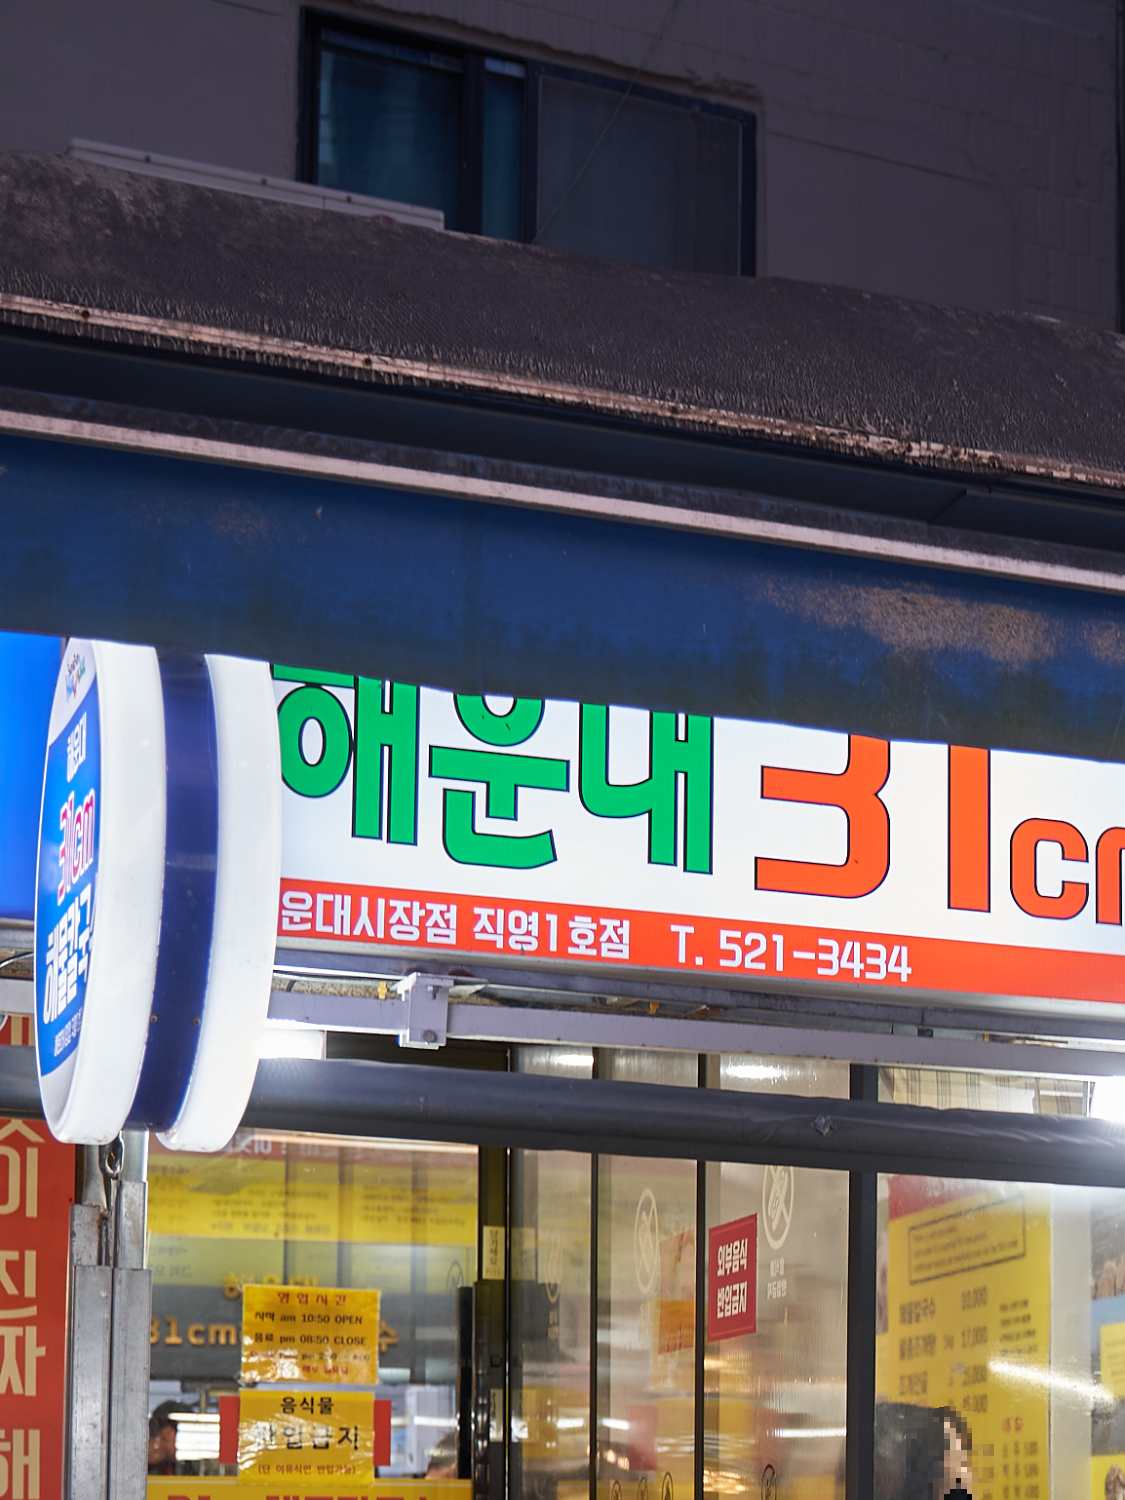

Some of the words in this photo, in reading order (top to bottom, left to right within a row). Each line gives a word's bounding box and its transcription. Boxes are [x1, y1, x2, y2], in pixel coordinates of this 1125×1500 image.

[66, 711, 87, 784] 해운대
[58, 788, 96, 907] 31cm
[43, 876, 95, 1025] 해물칼국
[472, 907, 631, 961] 직영1호점
[718, 929, 912, 983] 521-3434
[716, 1238, 749, 1277] 외부음식
[280, 1314, 297, 1323] am
[301, 1313, 331, 1324] 10:50
[334, 1314, 363, 1325] OPEN
[716, 1280, 749, 1320] 반입금지
[279, 1335, 296, 1345] pm
[299, 1334, 330, 1345] 08:50
[333, 1336, 367, 1346] CLOSE
[280, 1396, 334, 1415] 음식물
